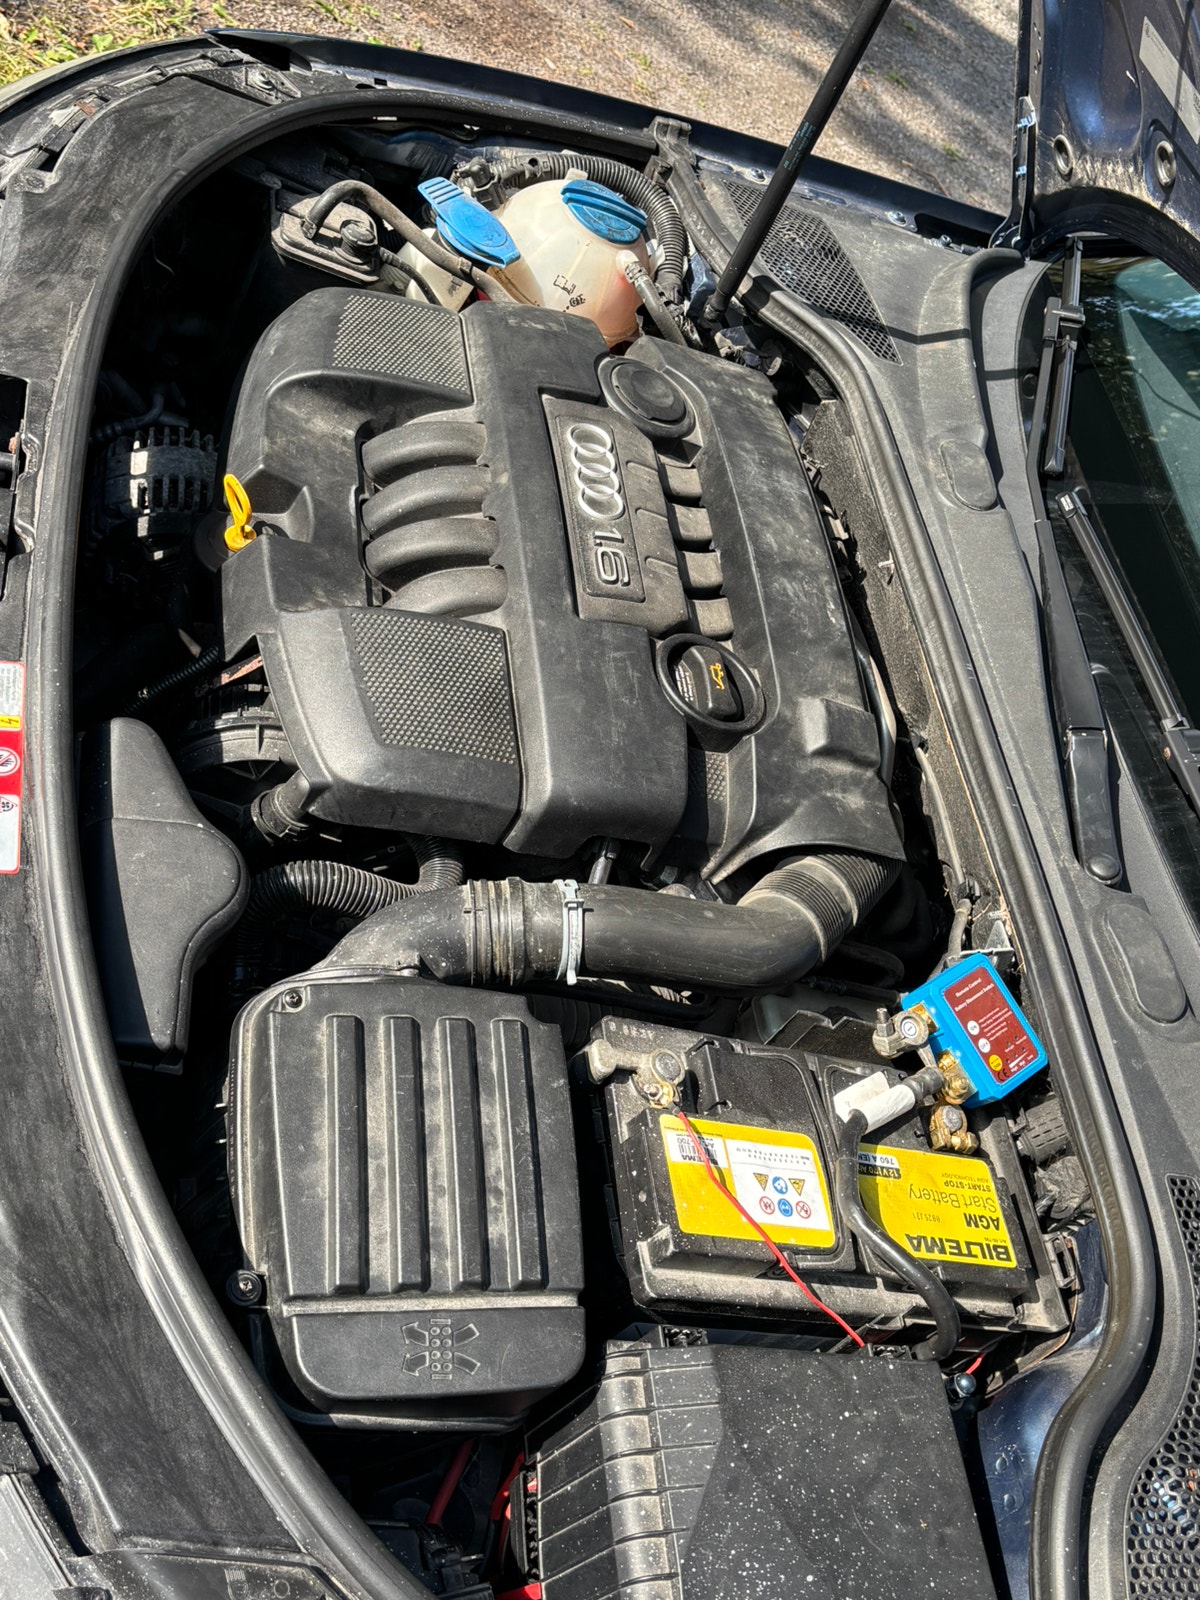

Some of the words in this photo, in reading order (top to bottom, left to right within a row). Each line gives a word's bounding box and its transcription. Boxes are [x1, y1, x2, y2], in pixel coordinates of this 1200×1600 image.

[593, 527, 631, 587] 1.6
[871, 1155, 877, 1163] A
[879, 1156, 895, 1166] 760
[944, 1180, 991, 1193] START-STOP
[909, 1184, 961, 1209] Battery
[961, 1194, 997, 1213] Start
[963, 1212, 1000, 1231] AGM
[905, 1233, 1012, 1262] BILTEMA
